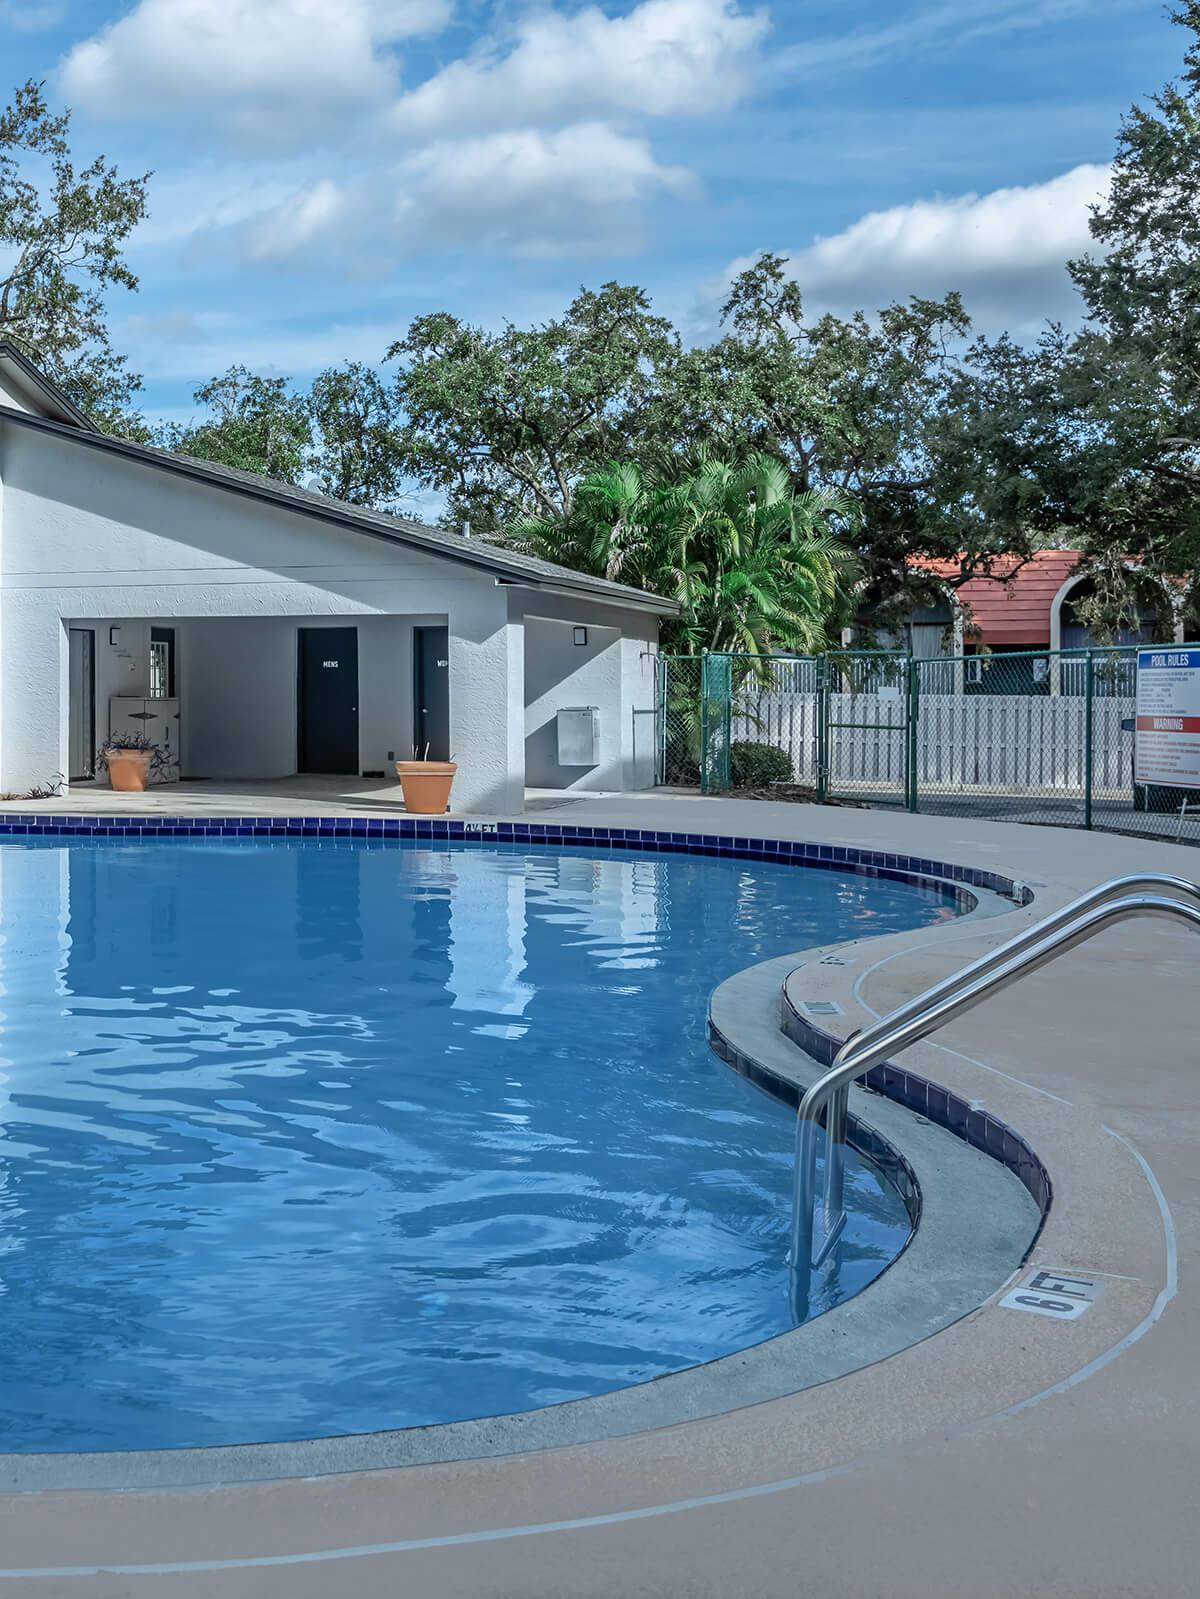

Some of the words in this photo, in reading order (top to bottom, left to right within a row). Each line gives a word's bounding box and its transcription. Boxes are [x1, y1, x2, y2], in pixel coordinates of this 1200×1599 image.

[1151, 654, 1167, 667] POOL
[1168, 653, 1189, 667] RULES
[1153, 718, 1183, 731] WARNING
[482, 823, 496, 833] FT
[1030, 1271, 1094, 1297] FT
[1014, 1295, 1075, 1313] 6
